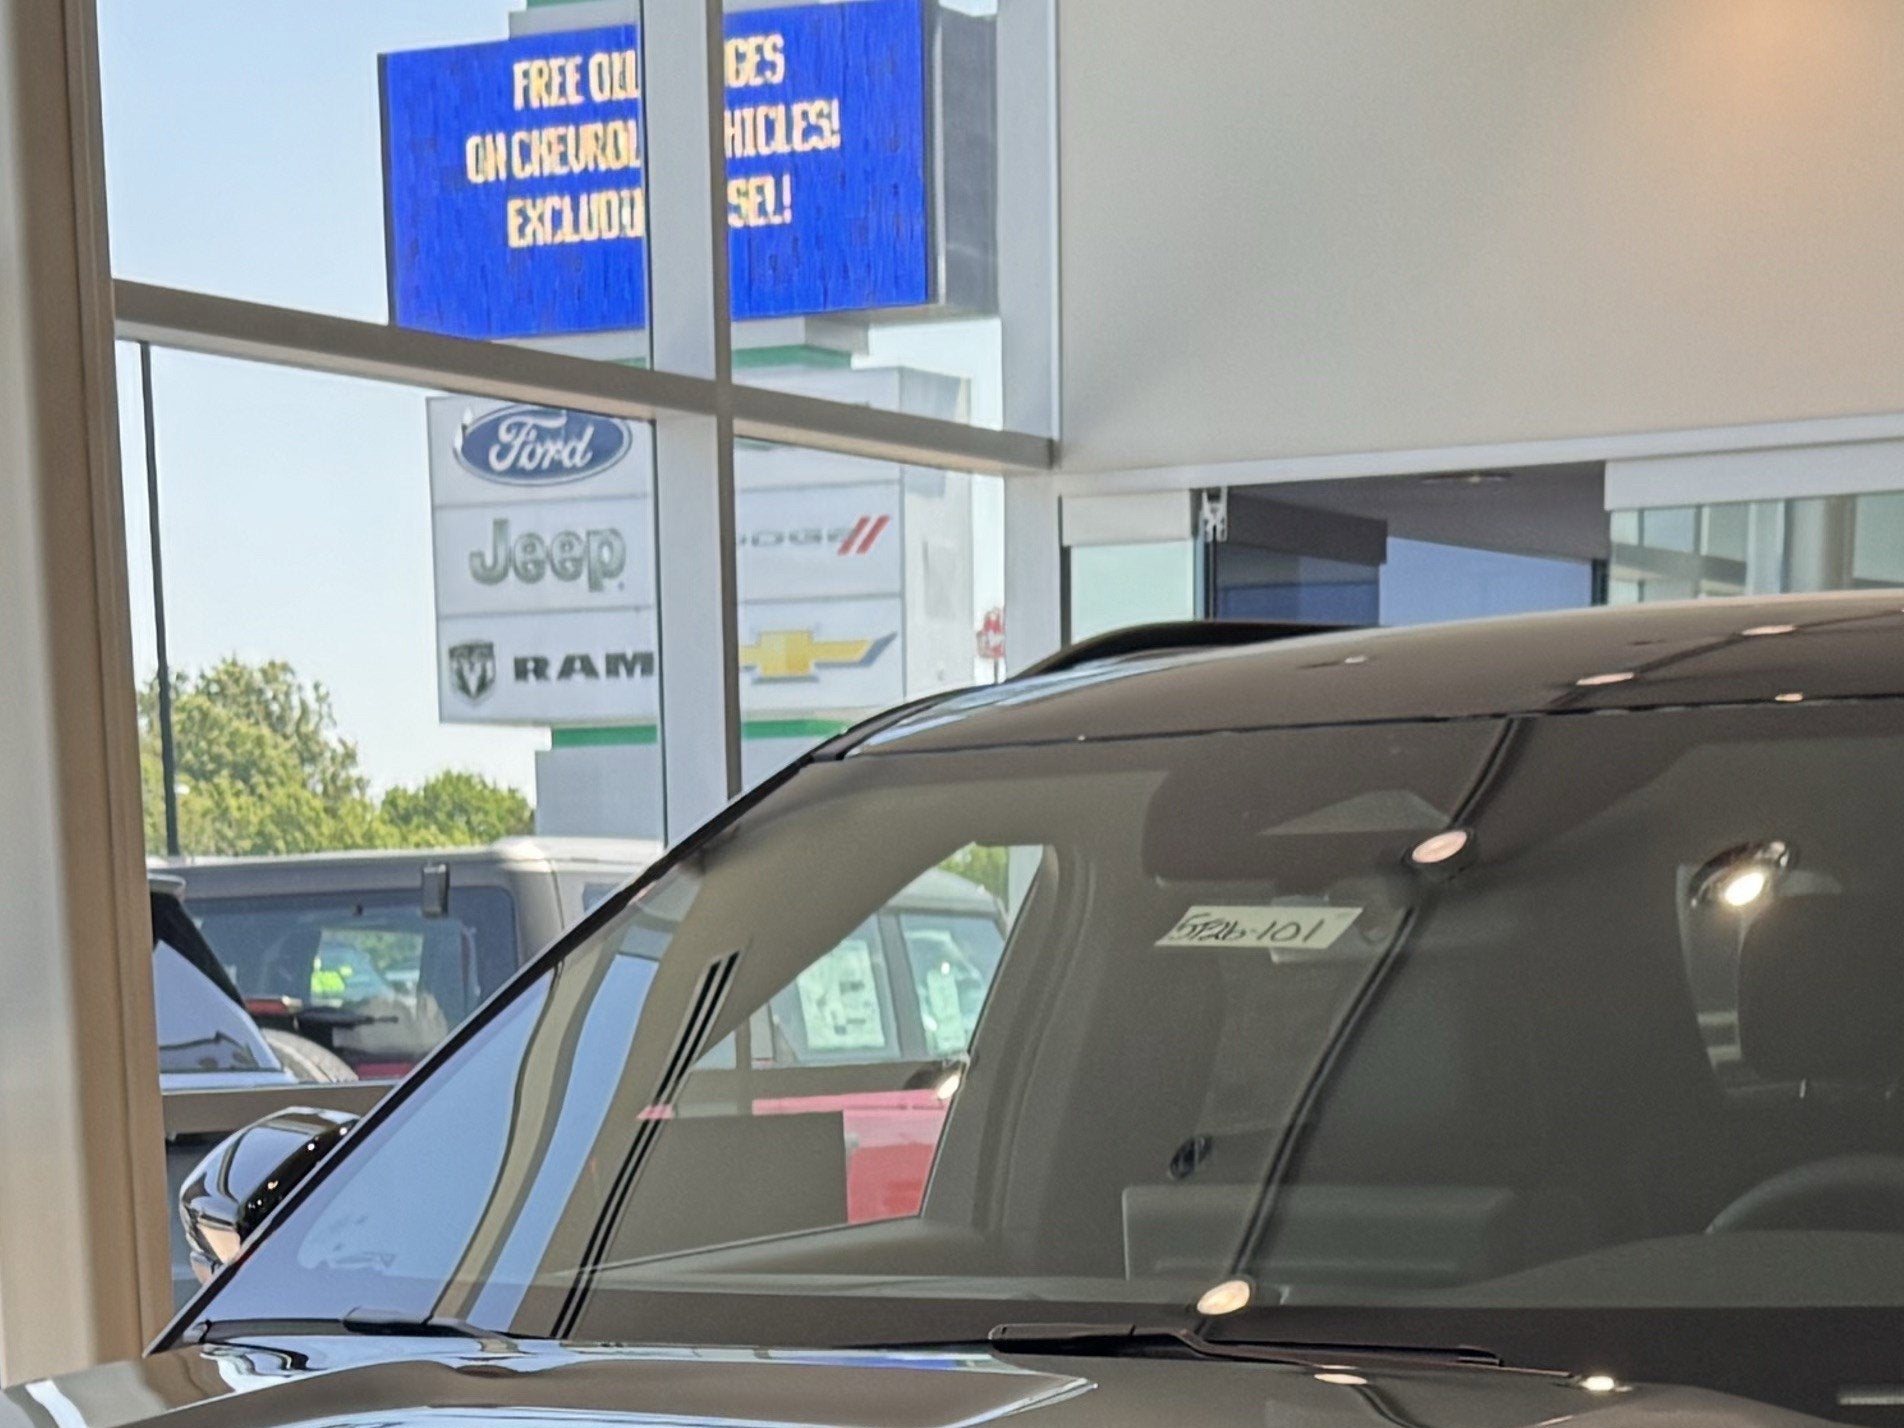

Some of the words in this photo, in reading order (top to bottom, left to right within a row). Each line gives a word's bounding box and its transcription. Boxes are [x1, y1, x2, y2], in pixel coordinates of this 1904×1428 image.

[513, 56, 585, 111] FREE
[589, 50, 639, 102] OIL
[724, 33, 786, 88] GES
[466, 132, 506, 184] ON
[511, 119, 642, 180] CHEVROL
[724, 98, 841, 159] HICLES!
[727, 172, 792, 228] SEL!
[489, 415, 595, 471] Ford
[469, 518, 627, 592] Jeep
[513, 652, 654, 681] RAM
